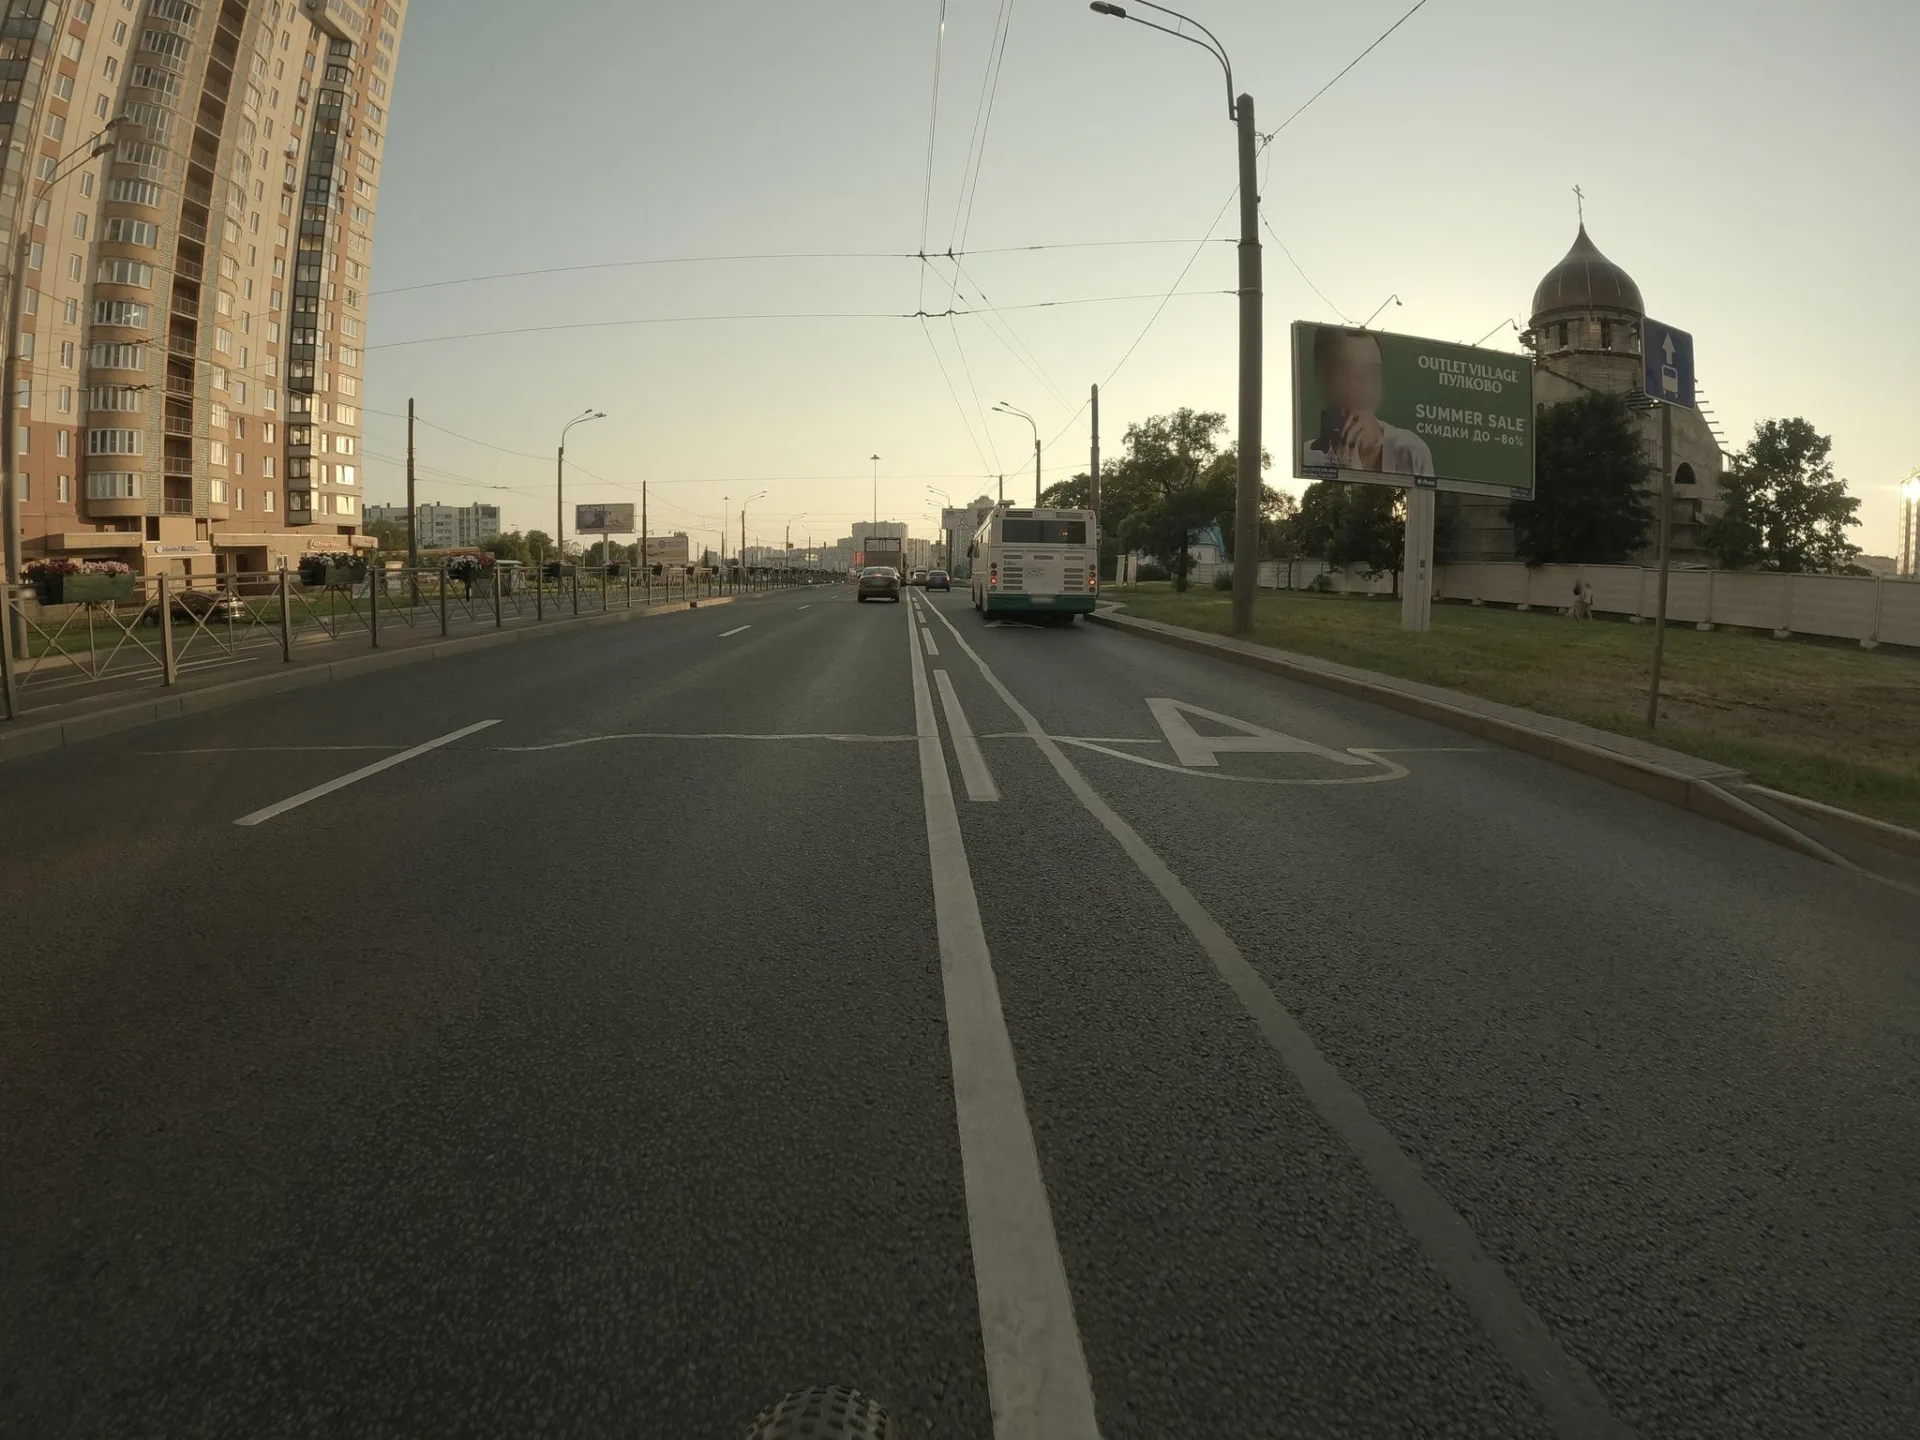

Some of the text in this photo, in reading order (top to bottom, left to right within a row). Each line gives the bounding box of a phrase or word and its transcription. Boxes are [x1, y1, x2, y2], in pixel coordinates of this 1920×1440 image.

[1418, 355, 1519, 383] OUTLET VILLAGE
[1439, 372, 1502, 393] ПУЛКОВО
[1416, 403, 1524, 432] SUMMER SALE
[1416, 422, 1469, 439] СКИДКИ
[1472, 429, 1490, 442] ДО
